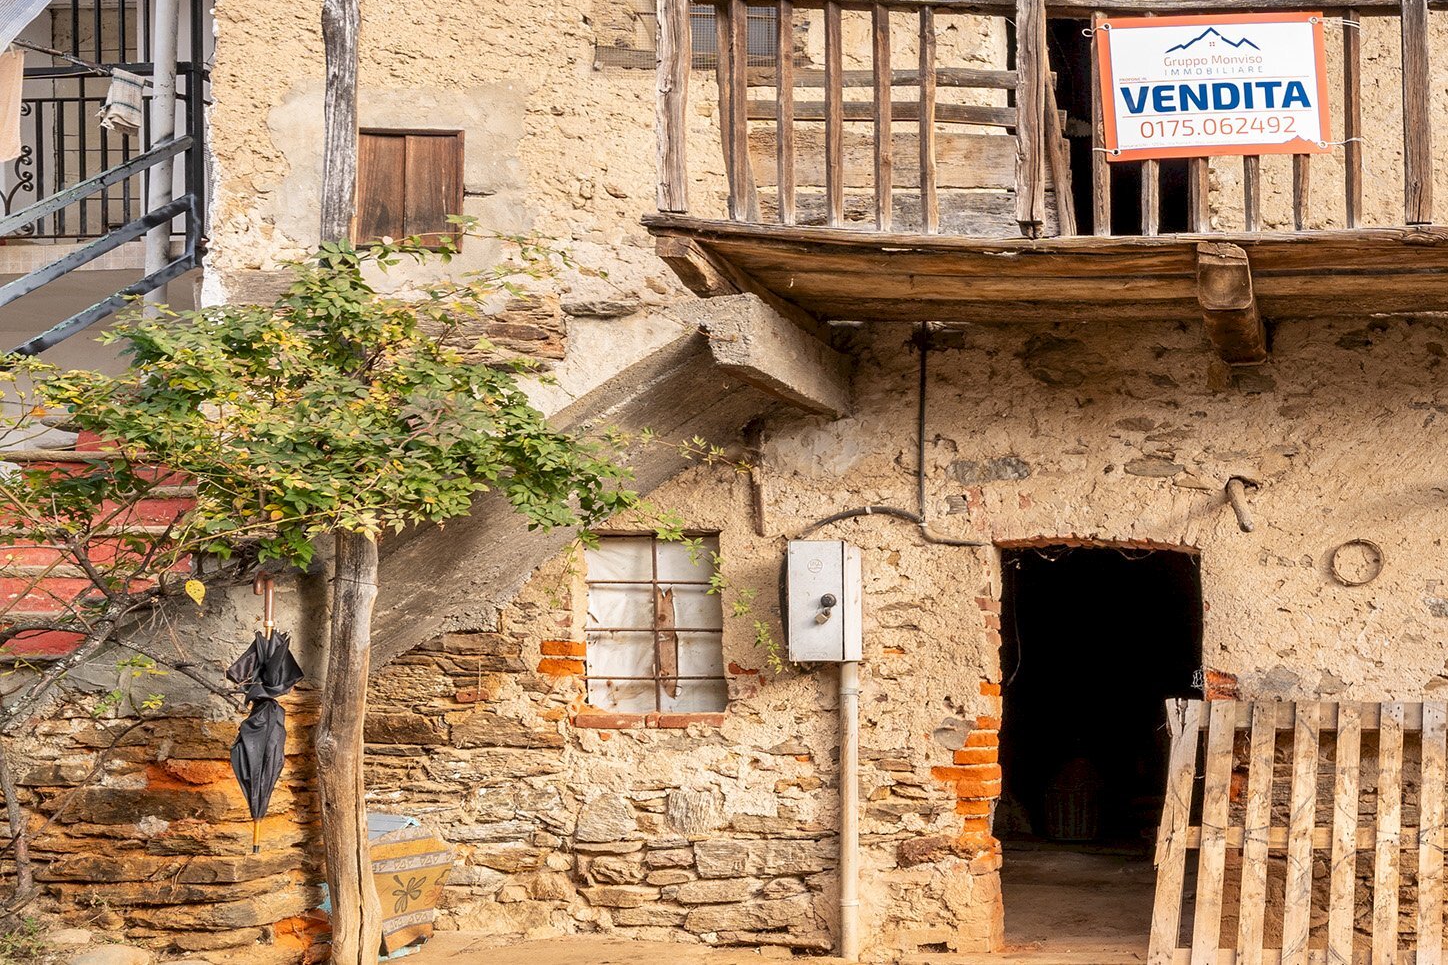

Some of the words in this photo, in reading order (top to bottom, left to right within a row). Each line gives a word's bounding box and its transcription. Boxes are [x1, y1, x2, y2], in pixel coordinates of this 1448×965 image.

[1163, 56, 1208, 67] Gruppo
[1211, 54, 1263, 64] Monviso
[1164, 65, 1263, 76] IMMOBILIARE
[1120, 81, 1311, 114] VENDITA
[1140, 116, 1297, 139] 0175.062492
